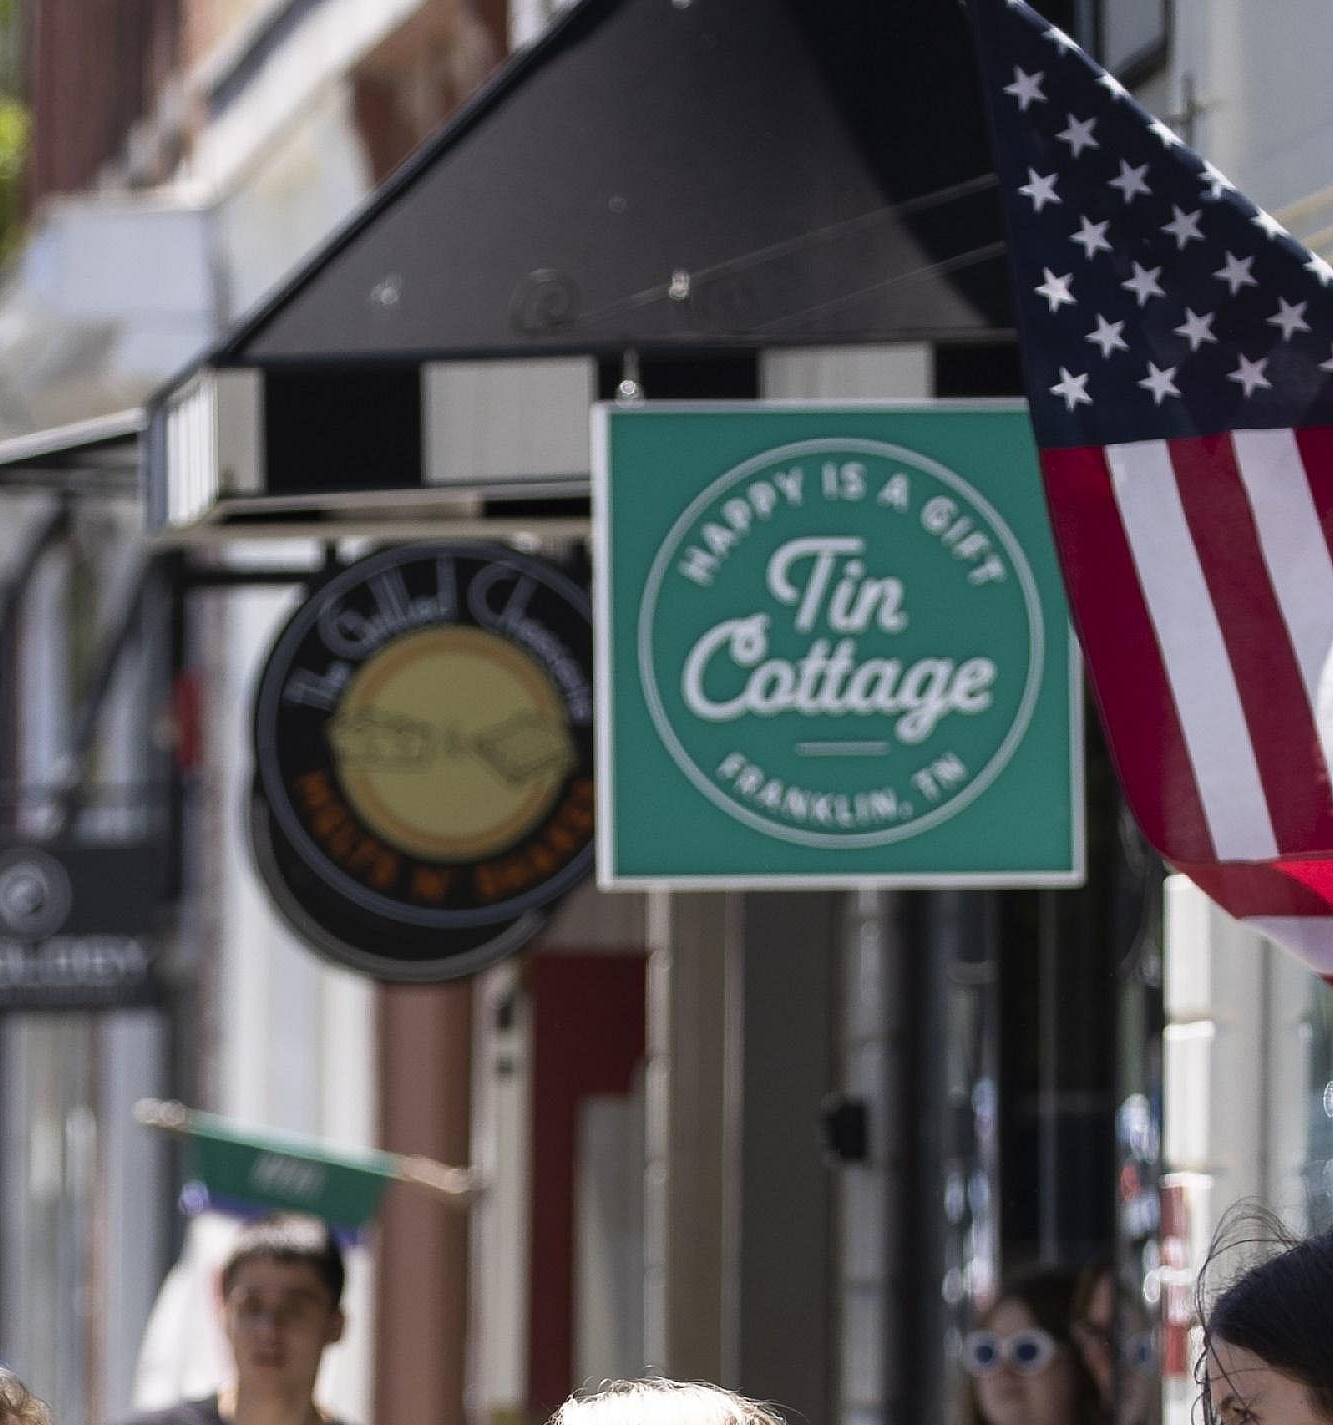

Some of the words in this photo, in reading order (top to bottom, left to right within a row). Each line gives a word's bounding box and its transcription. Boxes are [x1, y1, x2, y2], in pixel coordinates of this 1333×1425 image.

[678, 464, 805, 587] HAPPY
[821, 461, 868, 500] IS
[876, 471, 911, 513] A
[919, 494, 1007, 587] GIFT
[766, 535, 909, 635] Tin
[681, 612, 998, 743] Cottage
[715, 750, 914, 829] FRANKLIN,
[910, 750, 968, 801] TN
